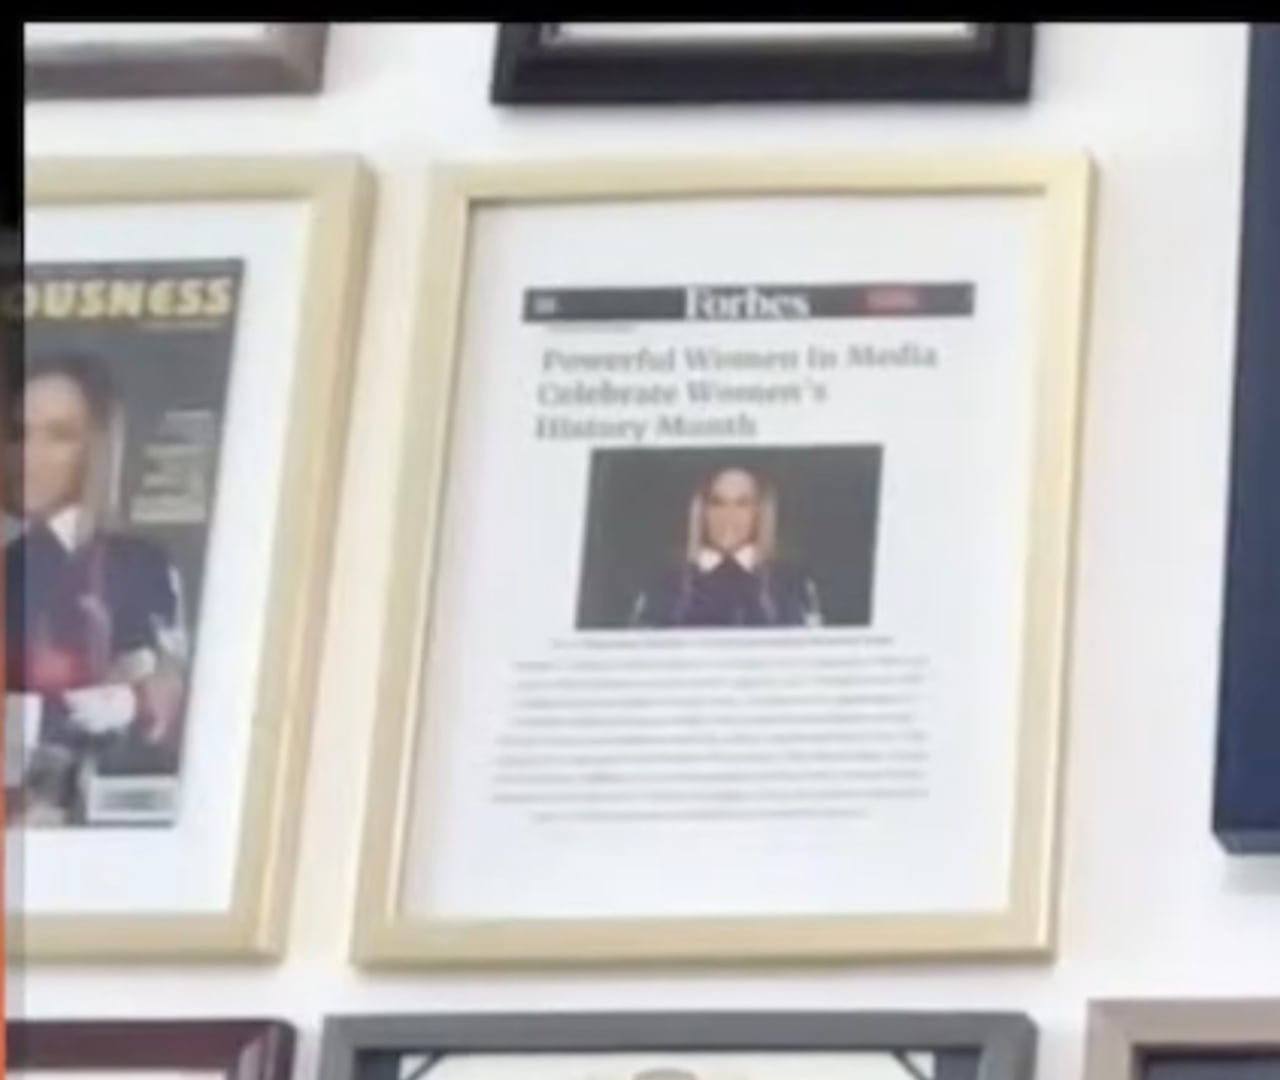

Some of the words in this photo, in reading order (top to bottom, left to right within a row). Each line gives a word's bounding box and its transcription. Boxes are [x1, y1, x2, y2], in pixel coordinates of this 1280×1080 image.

[685, 286, 810, 320] Forbes
[542, 346, 676, 372] Powerful
[684, 346, 799, 370] Women
[846, 342, 938, 368] Media
[537, 381, 678, 406] Celebrate
[686, 380, 828, 403] Women's
[535, 416, 648, 441] History
[655, 413, 757, 437] Month
